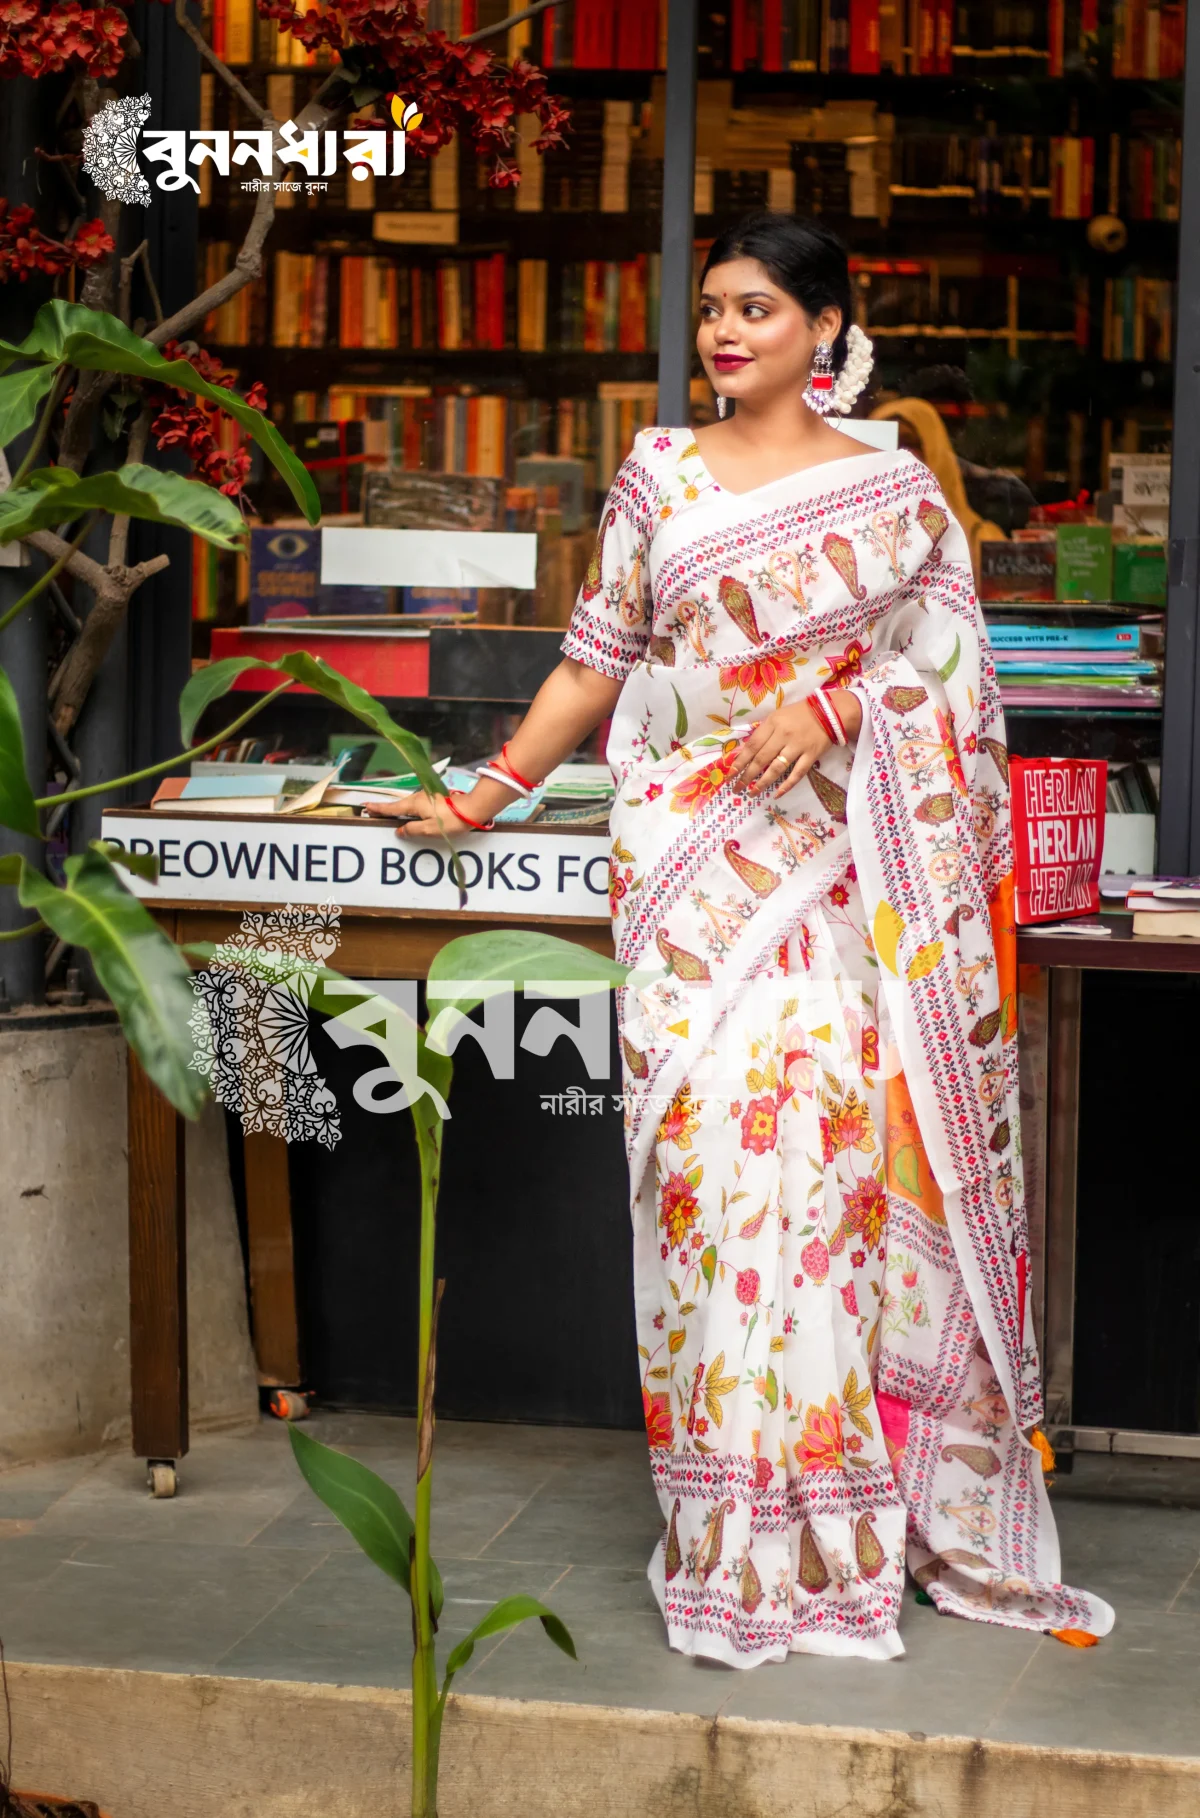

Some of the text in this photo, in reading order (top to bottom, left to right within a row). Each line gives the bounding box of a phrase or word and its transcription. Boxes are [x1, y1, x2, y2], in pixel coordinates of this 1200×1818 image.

[1024, 768, 1097, 818] HERLAN
[1027, 817, 1097, 865] HERLAN
[381, 847, 541, 892] BOOKS
[1030, 863, 1094, 916] HERLAN
